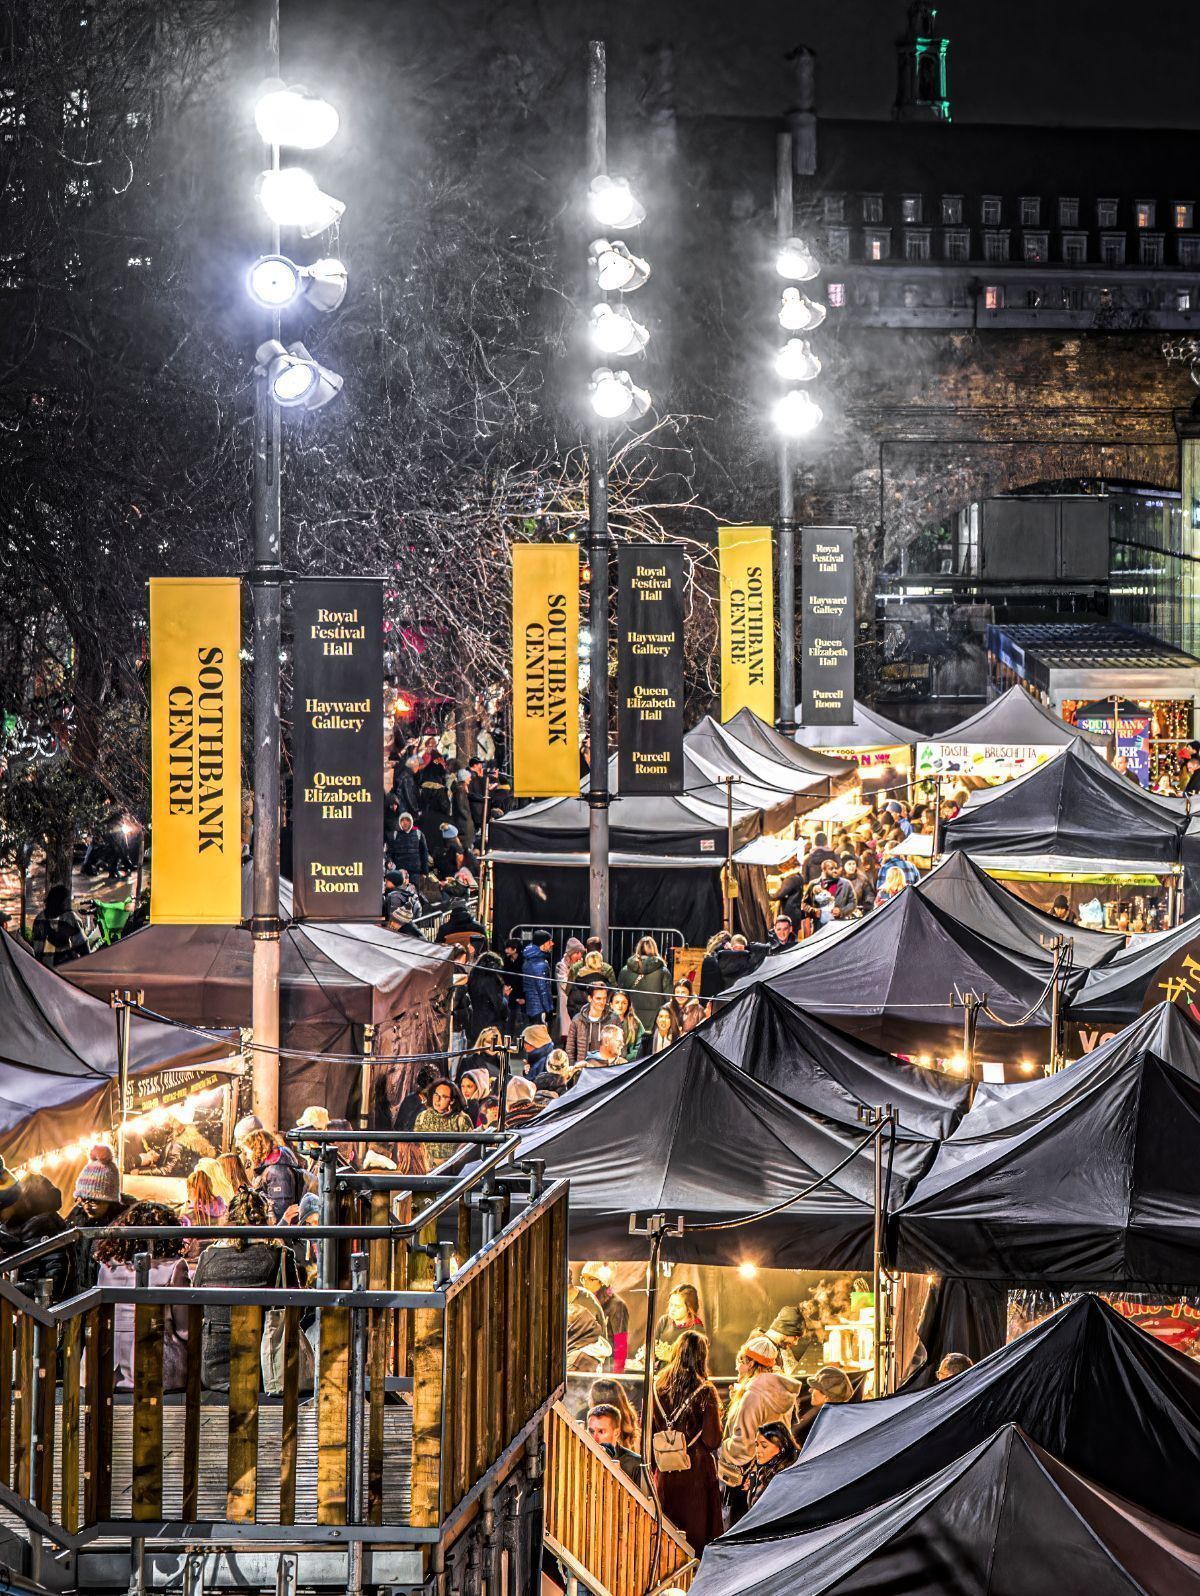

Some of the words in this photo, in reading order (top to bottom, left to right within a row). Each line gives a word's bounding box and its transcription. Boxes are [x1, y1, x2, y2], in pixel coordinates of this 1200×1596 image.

[816, 544, 840, 555] Royal
[812, 553, 844, 563] Festival
[636, 565, 667, 580] Royal
[819, 563, 837, 572] Hall
[631, 576, 672, 590] Festival
[639, 588, 663, 601] Hall
[809, 596, 848, 606] Hayward
[317, 608, 359, 626] Royal
[812, 606, 844, 616] Gallery
[310, 624, 366, 641] Festival
[730, 589, 746, 665] CENTRE
[747, 566, 764, 686] SOUTHBANK
[627, 631, 676, 646] Hayward
[814, 638, 842, 649] Queen
[322, 641, 354, 656] Hall
[631, 642, 671, 658] Gallery
[808, 647, 848, 657] Elizabeth
[819, 657, 838, 666] Hall
[525, 622, 546, 720] CENTRE
[547, 594, 568, 746] SOUTHBANK
[633, 685, 669, 700] Queen
[812, 690, 844, 699] Purcell
[305, 698, 371, 718] Hayward
[626, 696, 676, 710] Elizabeth
[814, 699, 842, 708] Room
[640, 708, 662, 721] Hall
[312, 713, 364, 733] Gallery
[168, 684, 194, 817] CENTRE
[197, 646, 225, 854] SOUTHBANK
[632, 751, 671, 764] Purcell
[634, 762, 668, 775] Room
[312, 772, 362, 789] Queen
[304, 786, 372, 804] Elizabeth
[322, 804, 353, 820] Hall
[310, 862, 364, 878] Purcell
[314, 878, 360, 894] Room
[138, 1076, 160, 1098] STEAK
